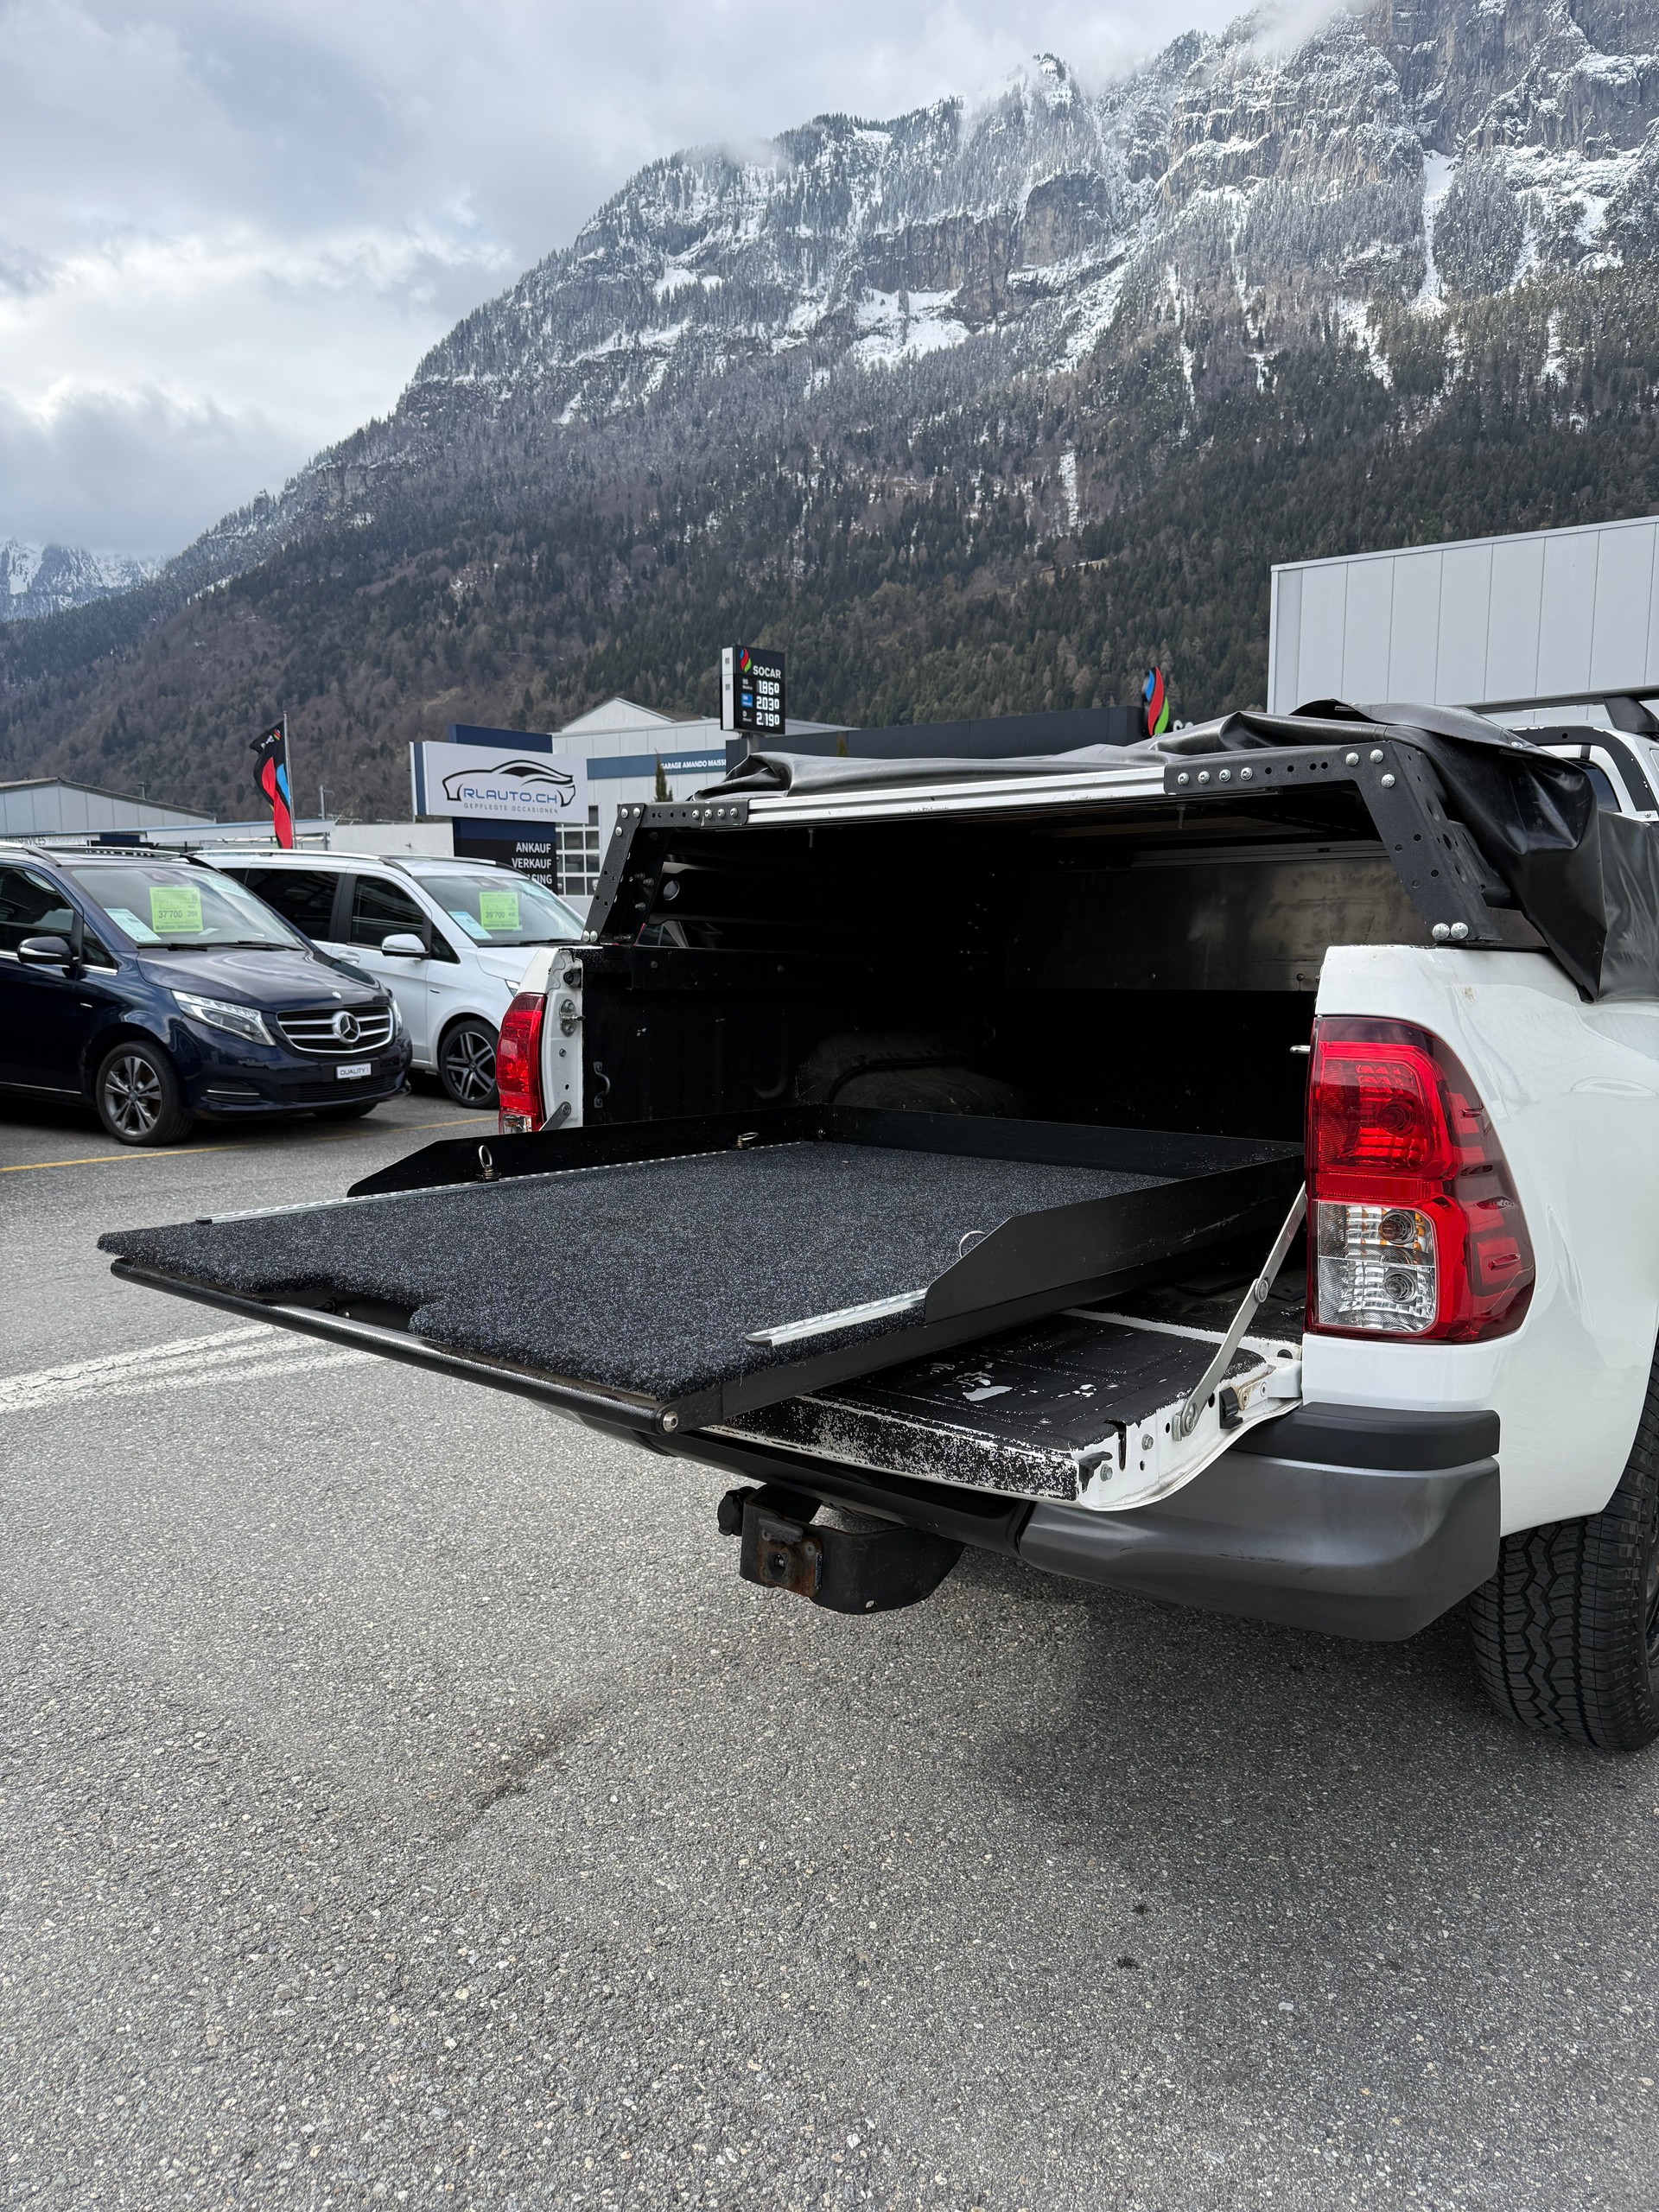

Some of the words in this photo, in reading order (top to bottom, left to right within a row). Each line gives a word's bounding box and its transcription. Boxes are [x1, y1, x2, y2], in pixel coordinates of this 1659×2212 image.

[753, 664, 782, 679] SOCAR
[682, 760, 707, 768] AMANDO
[463, 787, 558, 804] RLAUTO.CH
[464, 802, 508, 811] GEPFLEGTE
[512, 805, 559, 814] OCCASIONEN
[515, 842, 551, 854] ANKAUF
[511, 857, 552, 869] VERKAUF
